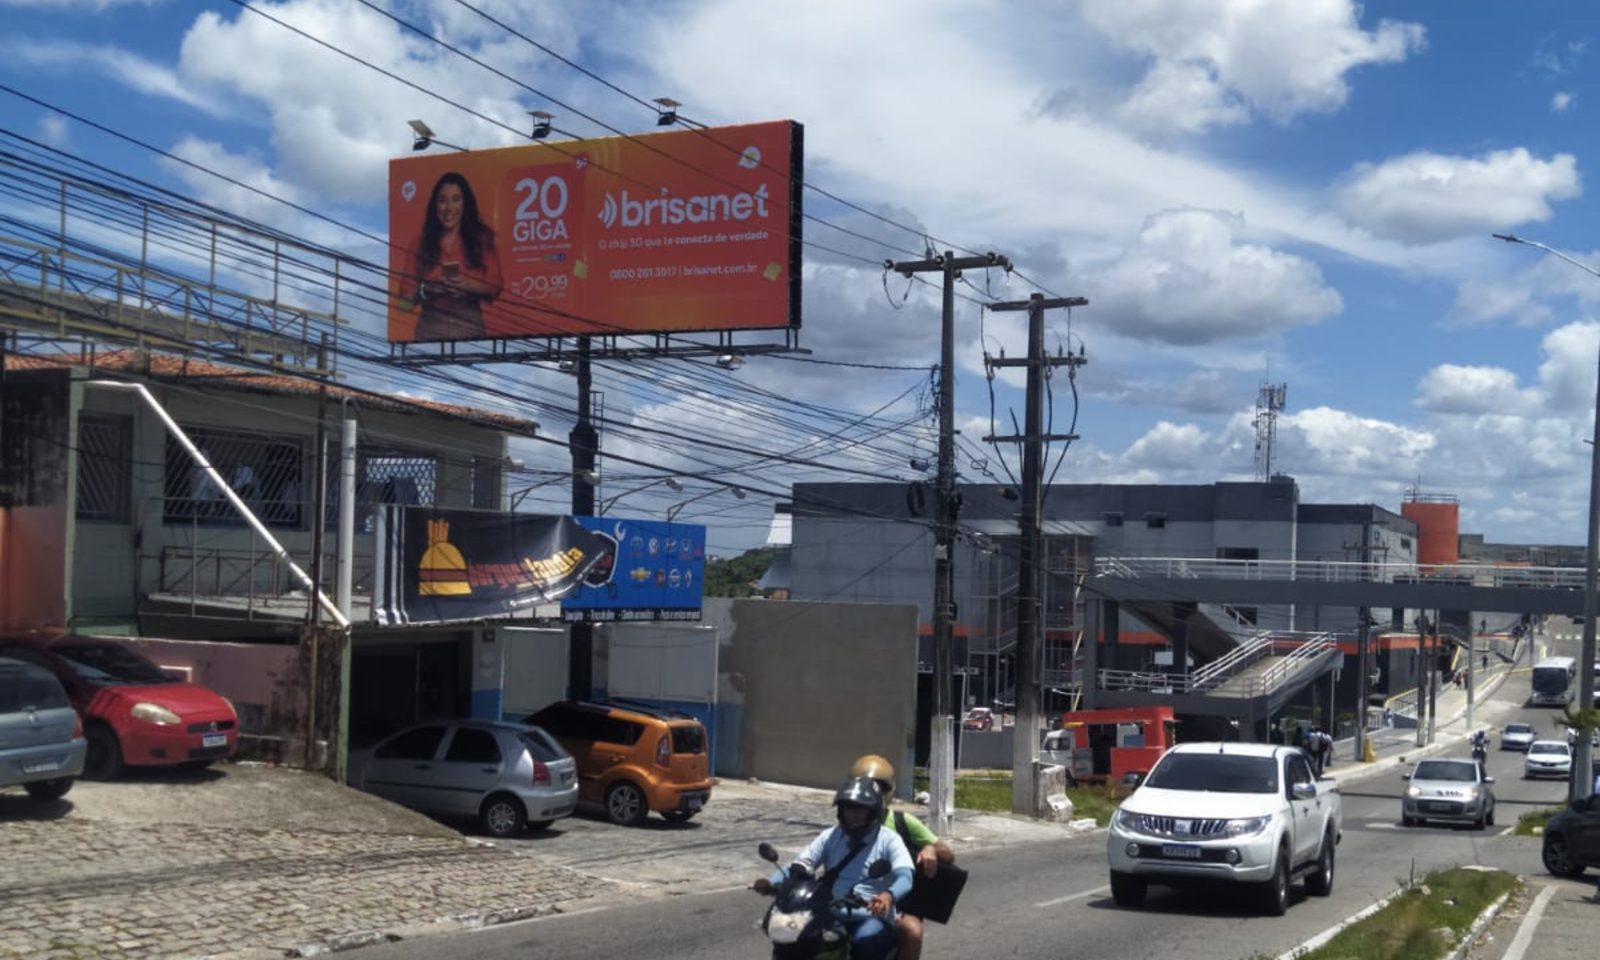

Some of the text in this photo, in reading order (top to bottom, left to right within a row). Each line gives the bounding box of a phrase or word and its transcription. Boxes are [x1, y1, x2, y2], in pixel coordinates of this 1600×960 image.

[514, 176, 568, 220] 20
[621, 184, 769, 227] brisanet
[513, 219, 569, 242] GIGA
[598, 238, 608, 251] O
[645, 237, 661, 249] que
[663, 235, 672, 246] te
[674, 233, 713, 246] conecta
[715, 231, 727, 243] de
[729, 229, 769, 242] verdade
[609, 267, 636, 281] 0800
[683, 263, 757, 277] brisanet.com.br
